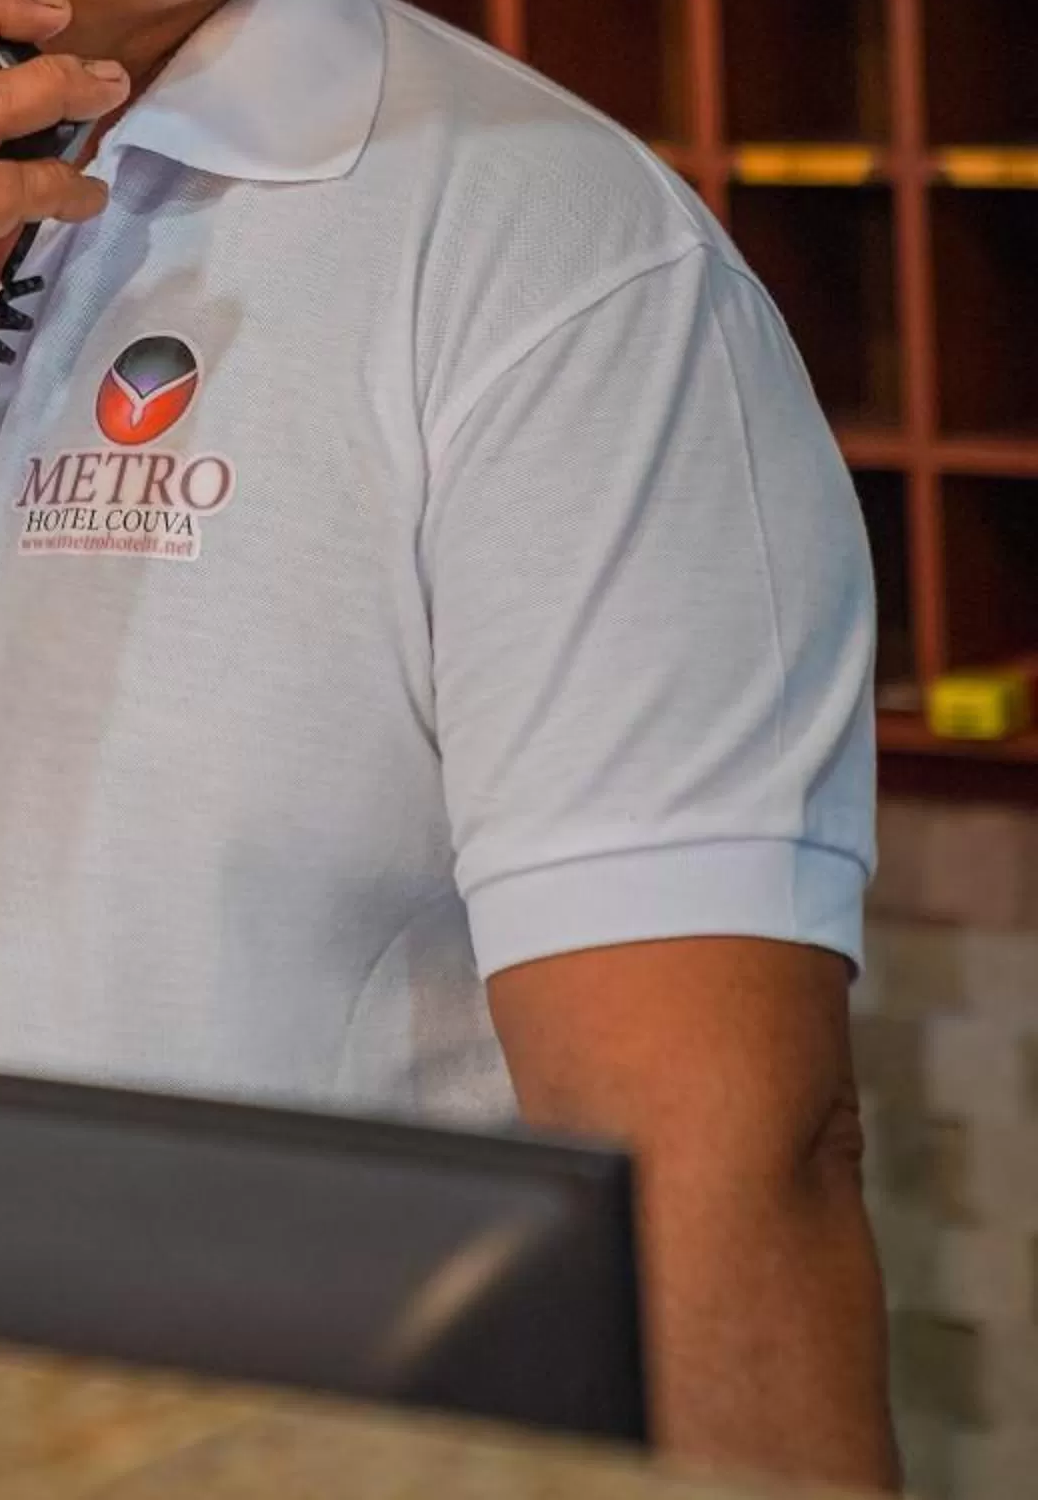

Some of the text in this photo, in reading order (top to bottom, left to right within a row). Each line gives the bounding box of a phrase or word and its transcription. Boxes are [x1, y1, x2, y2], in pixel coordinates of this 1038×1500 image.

[15, 451, 230, 510] METRO
[25, 508, 194, 537] HOTEL COUVA
